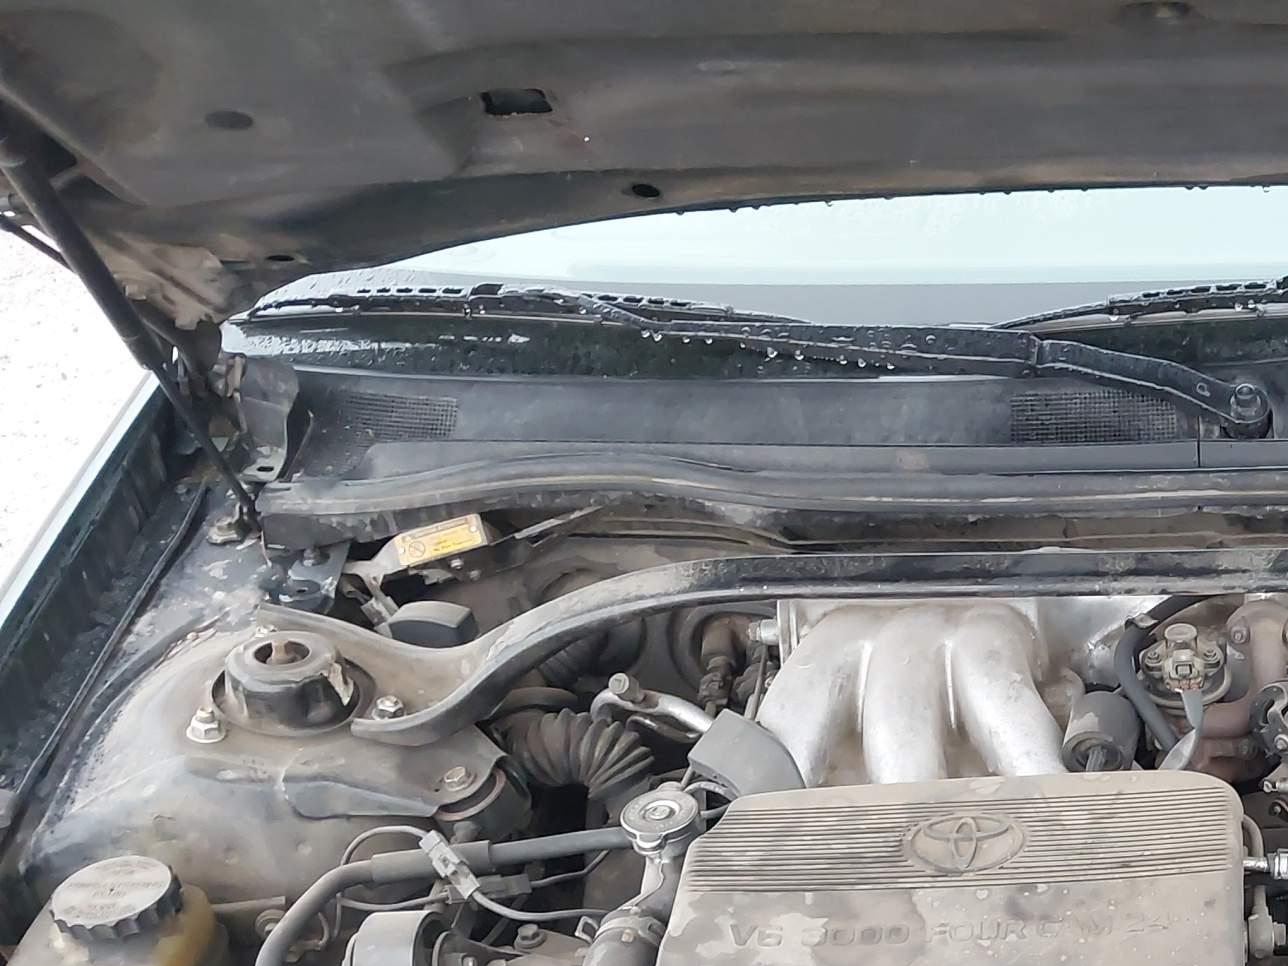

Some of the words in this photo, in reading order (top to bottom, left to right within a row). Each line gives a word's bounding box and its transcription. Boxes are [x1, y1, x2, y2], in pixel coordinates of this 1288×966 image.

[729, 924, 784, 947] V6
[801, 923, 910, 947] 3000
[927, 919, 1027, 943] FOUR
